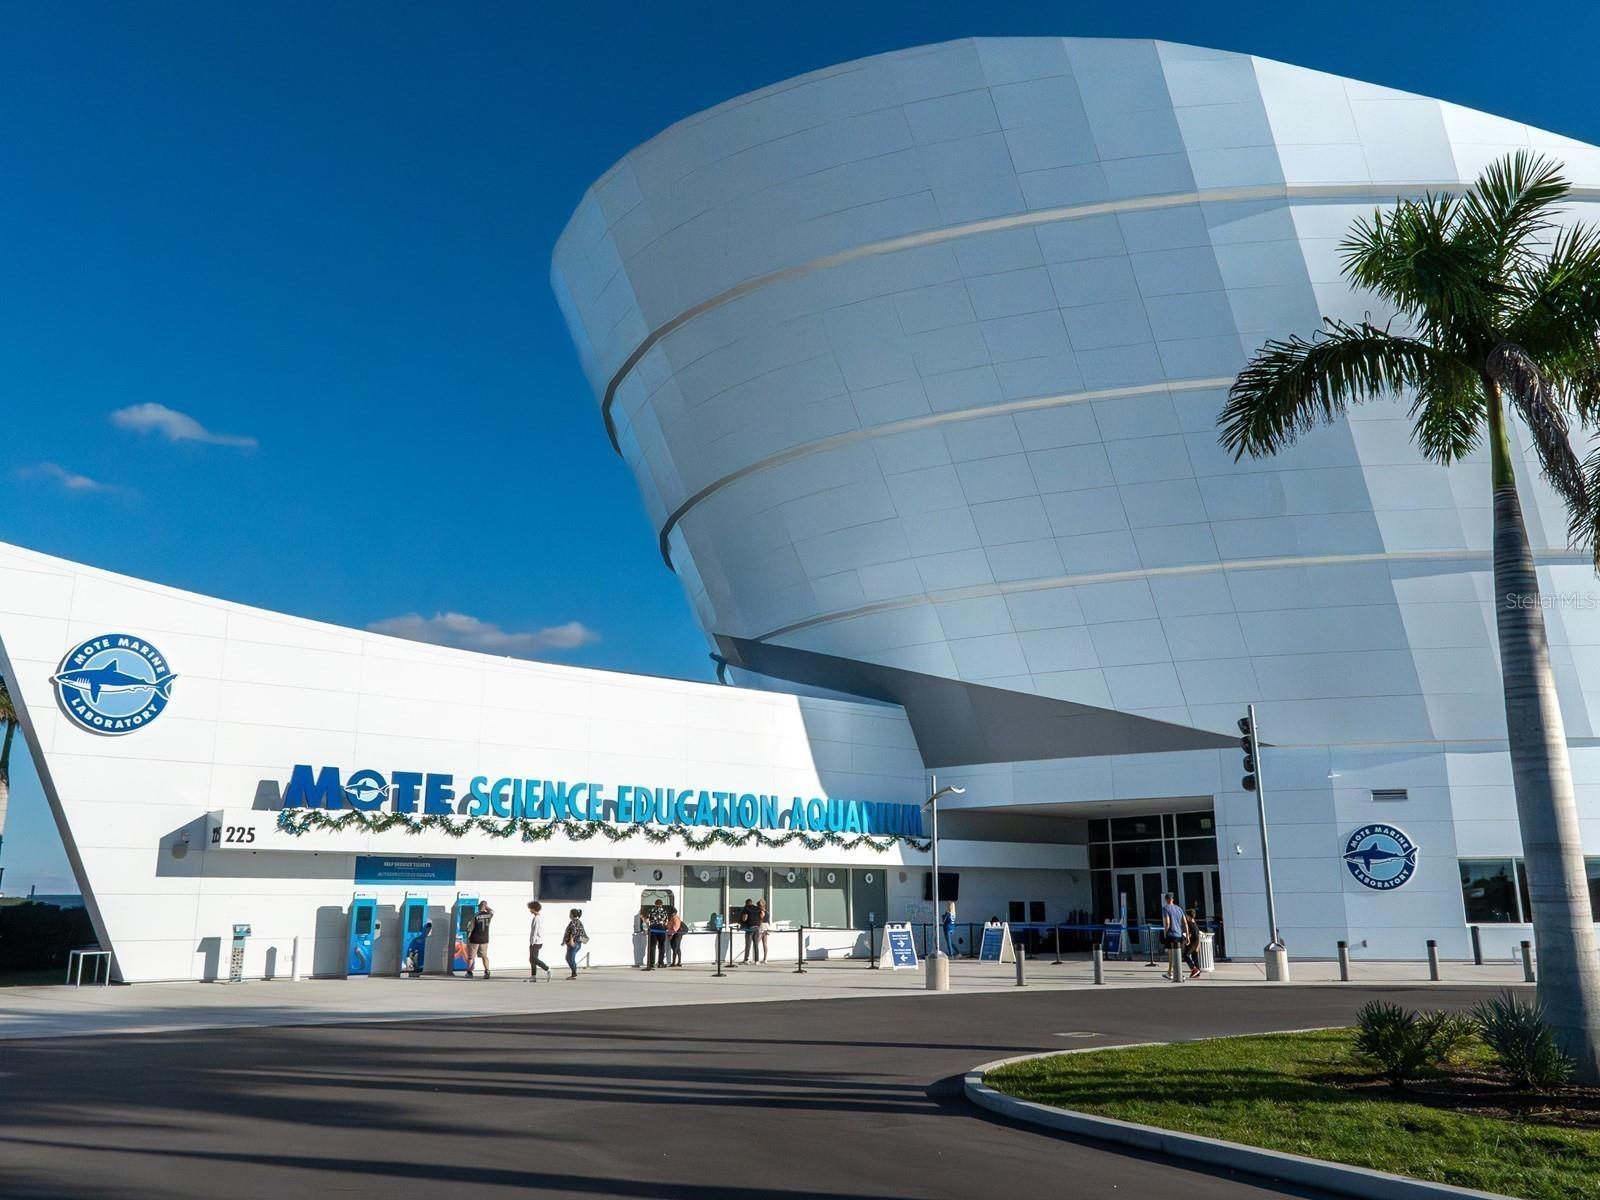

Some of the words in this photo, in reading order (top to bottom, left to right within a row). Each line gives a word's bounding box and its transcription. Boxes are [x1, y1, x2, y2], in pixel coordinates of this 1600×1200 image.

[74, 638, 110, 665] MOTE
[117, 637, 166, 674] MARINE
[71, 697, 158, 729] LABORATORY
[283, 764, 456, 815] MOTE
[469, 776, 603, 823] SCIENCE
[617, 785, 778, 831] EDUCATION
[788, 796, 924, 836] AQUARIUM
[224, 826, 256, 844] 225
[1350, 828, 1370, 848] MOTE
[1375, 827, 1409, 848] MARINE
[1355, 869, 1409, 888] LABORATORY
